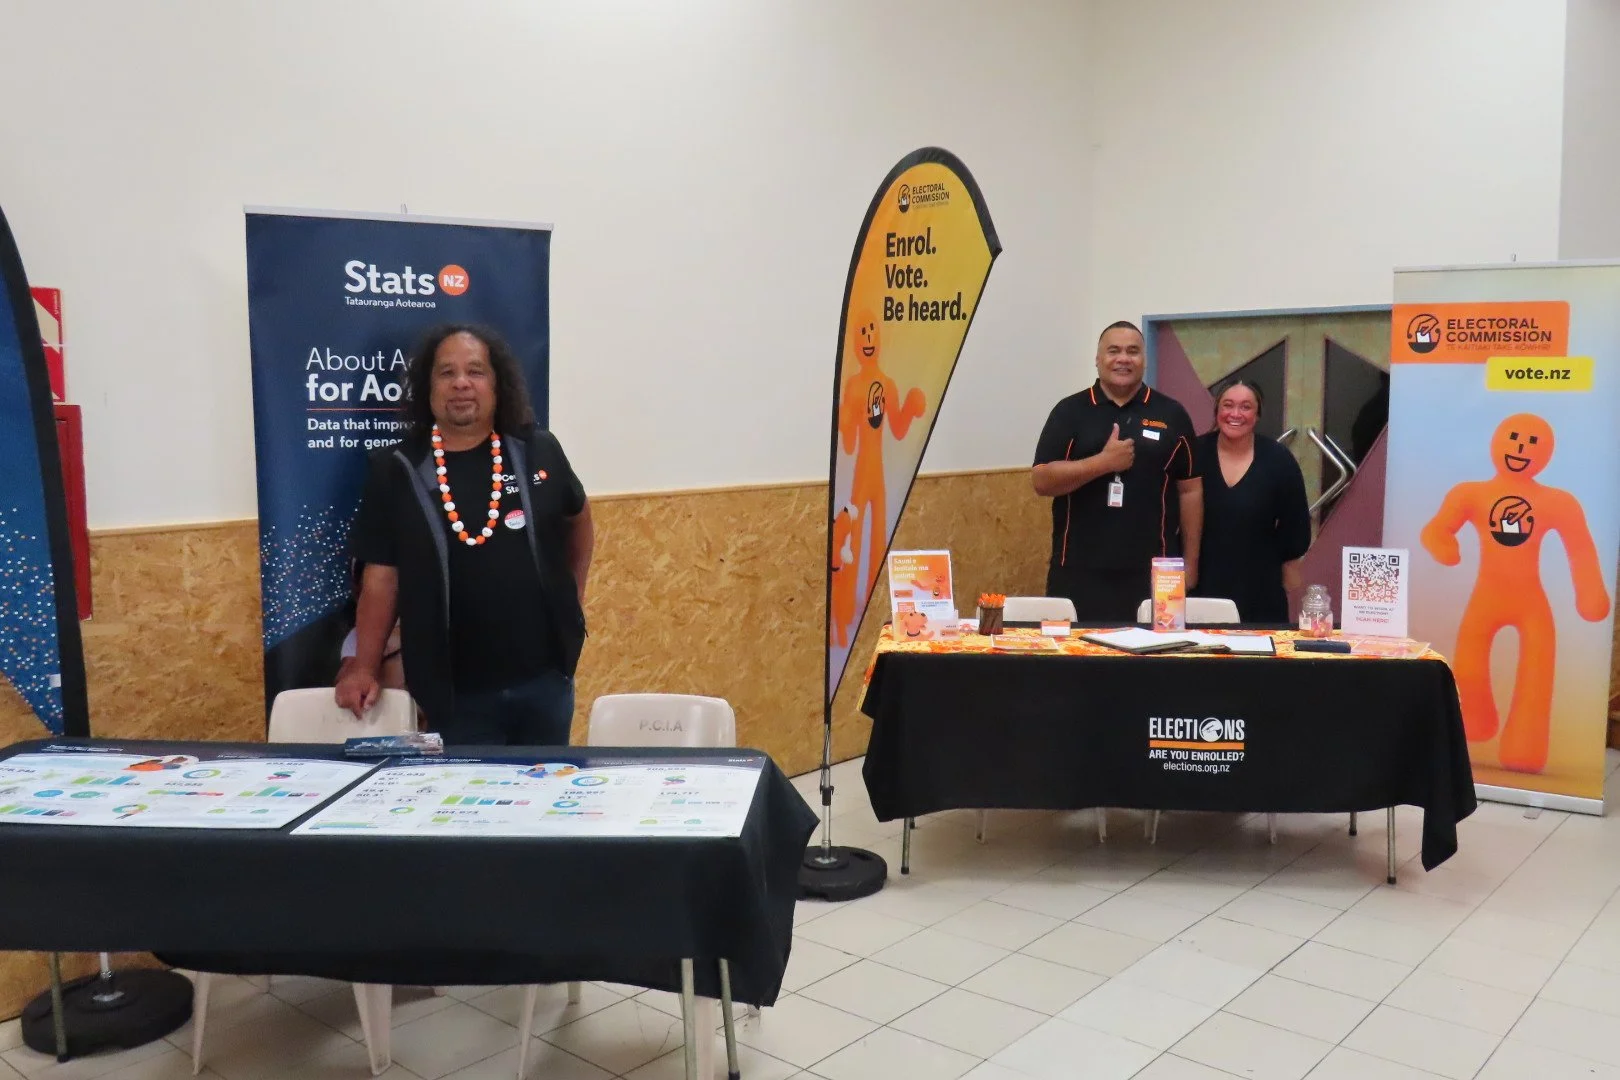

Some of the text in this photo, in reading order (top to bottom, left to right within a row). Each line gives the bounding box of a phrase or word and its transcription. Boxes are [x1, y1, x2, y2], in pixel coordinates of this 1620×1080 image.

[912, 183, 945, 195] ELECTORAL
[911, 191, 950, 204] COMMISSION
[886, 227, 936, 258] Enrol.
[344, 260, 464, 295] Stats NZ
[885, 264, 928, 288] Vote.
[345, 296, 436, 309] Tatauranga Aotearoa
[883, 291, 967, 322] Be heard.
[1447, 318, 1539, 330] ELECTORAL
[1446, 331, 1552, 343] COMMISSION
[306, 347, 408, 371] About A
[1505, 367, 1571, 380] vote.nz
[305, 373, 403, 401] for Ao
[308, 418, 340, 430] Data
[343, 418, 371, 430] that
[308, 436, 403, 450] and for gener
[505, 485, 520, 495] Sta
[1149, 750, 1245, 762] ARE YOU ENROLLED?
[1163, 761, 1230, 775] elections.org.nz
